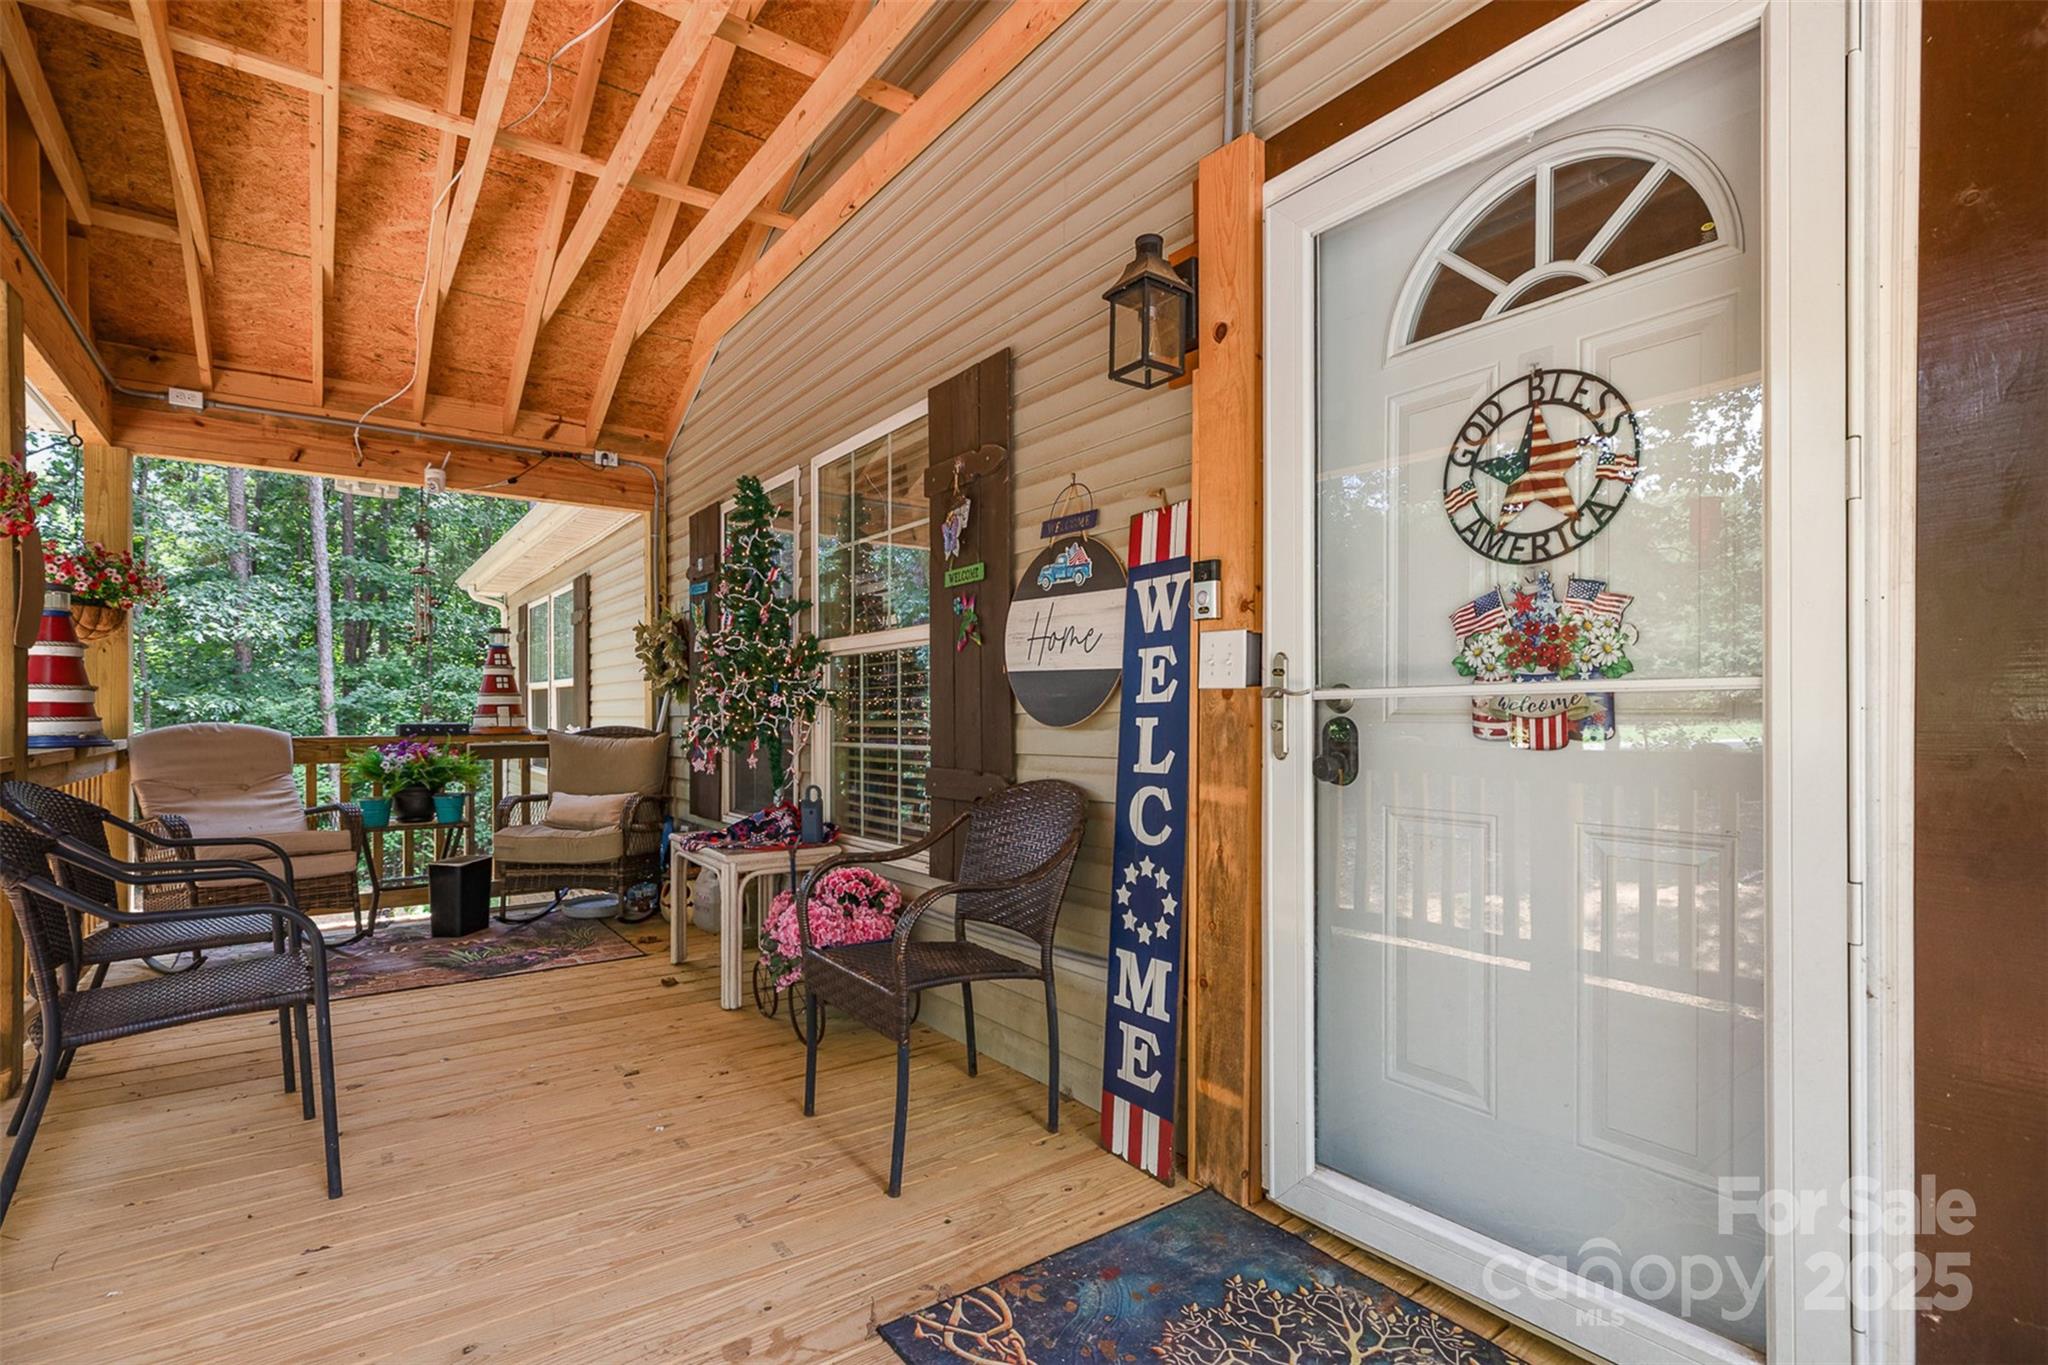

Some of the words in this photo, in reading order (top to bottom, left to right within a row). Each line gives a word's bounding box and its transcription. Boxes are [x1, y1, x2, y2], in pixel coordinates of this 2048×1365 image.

[1450, 400, 1504, 467] GOD
[1528, 370, 1634, 437] BLESS
[1461, 499, 1617, 562] AMERICA
[948, 566, 979, 583] WELCOME
[1027, 602, 1102, 666] Home
[1497, 692, 1582, 713] welcome
[1113, 570, 1191, 1094] WELCOME
